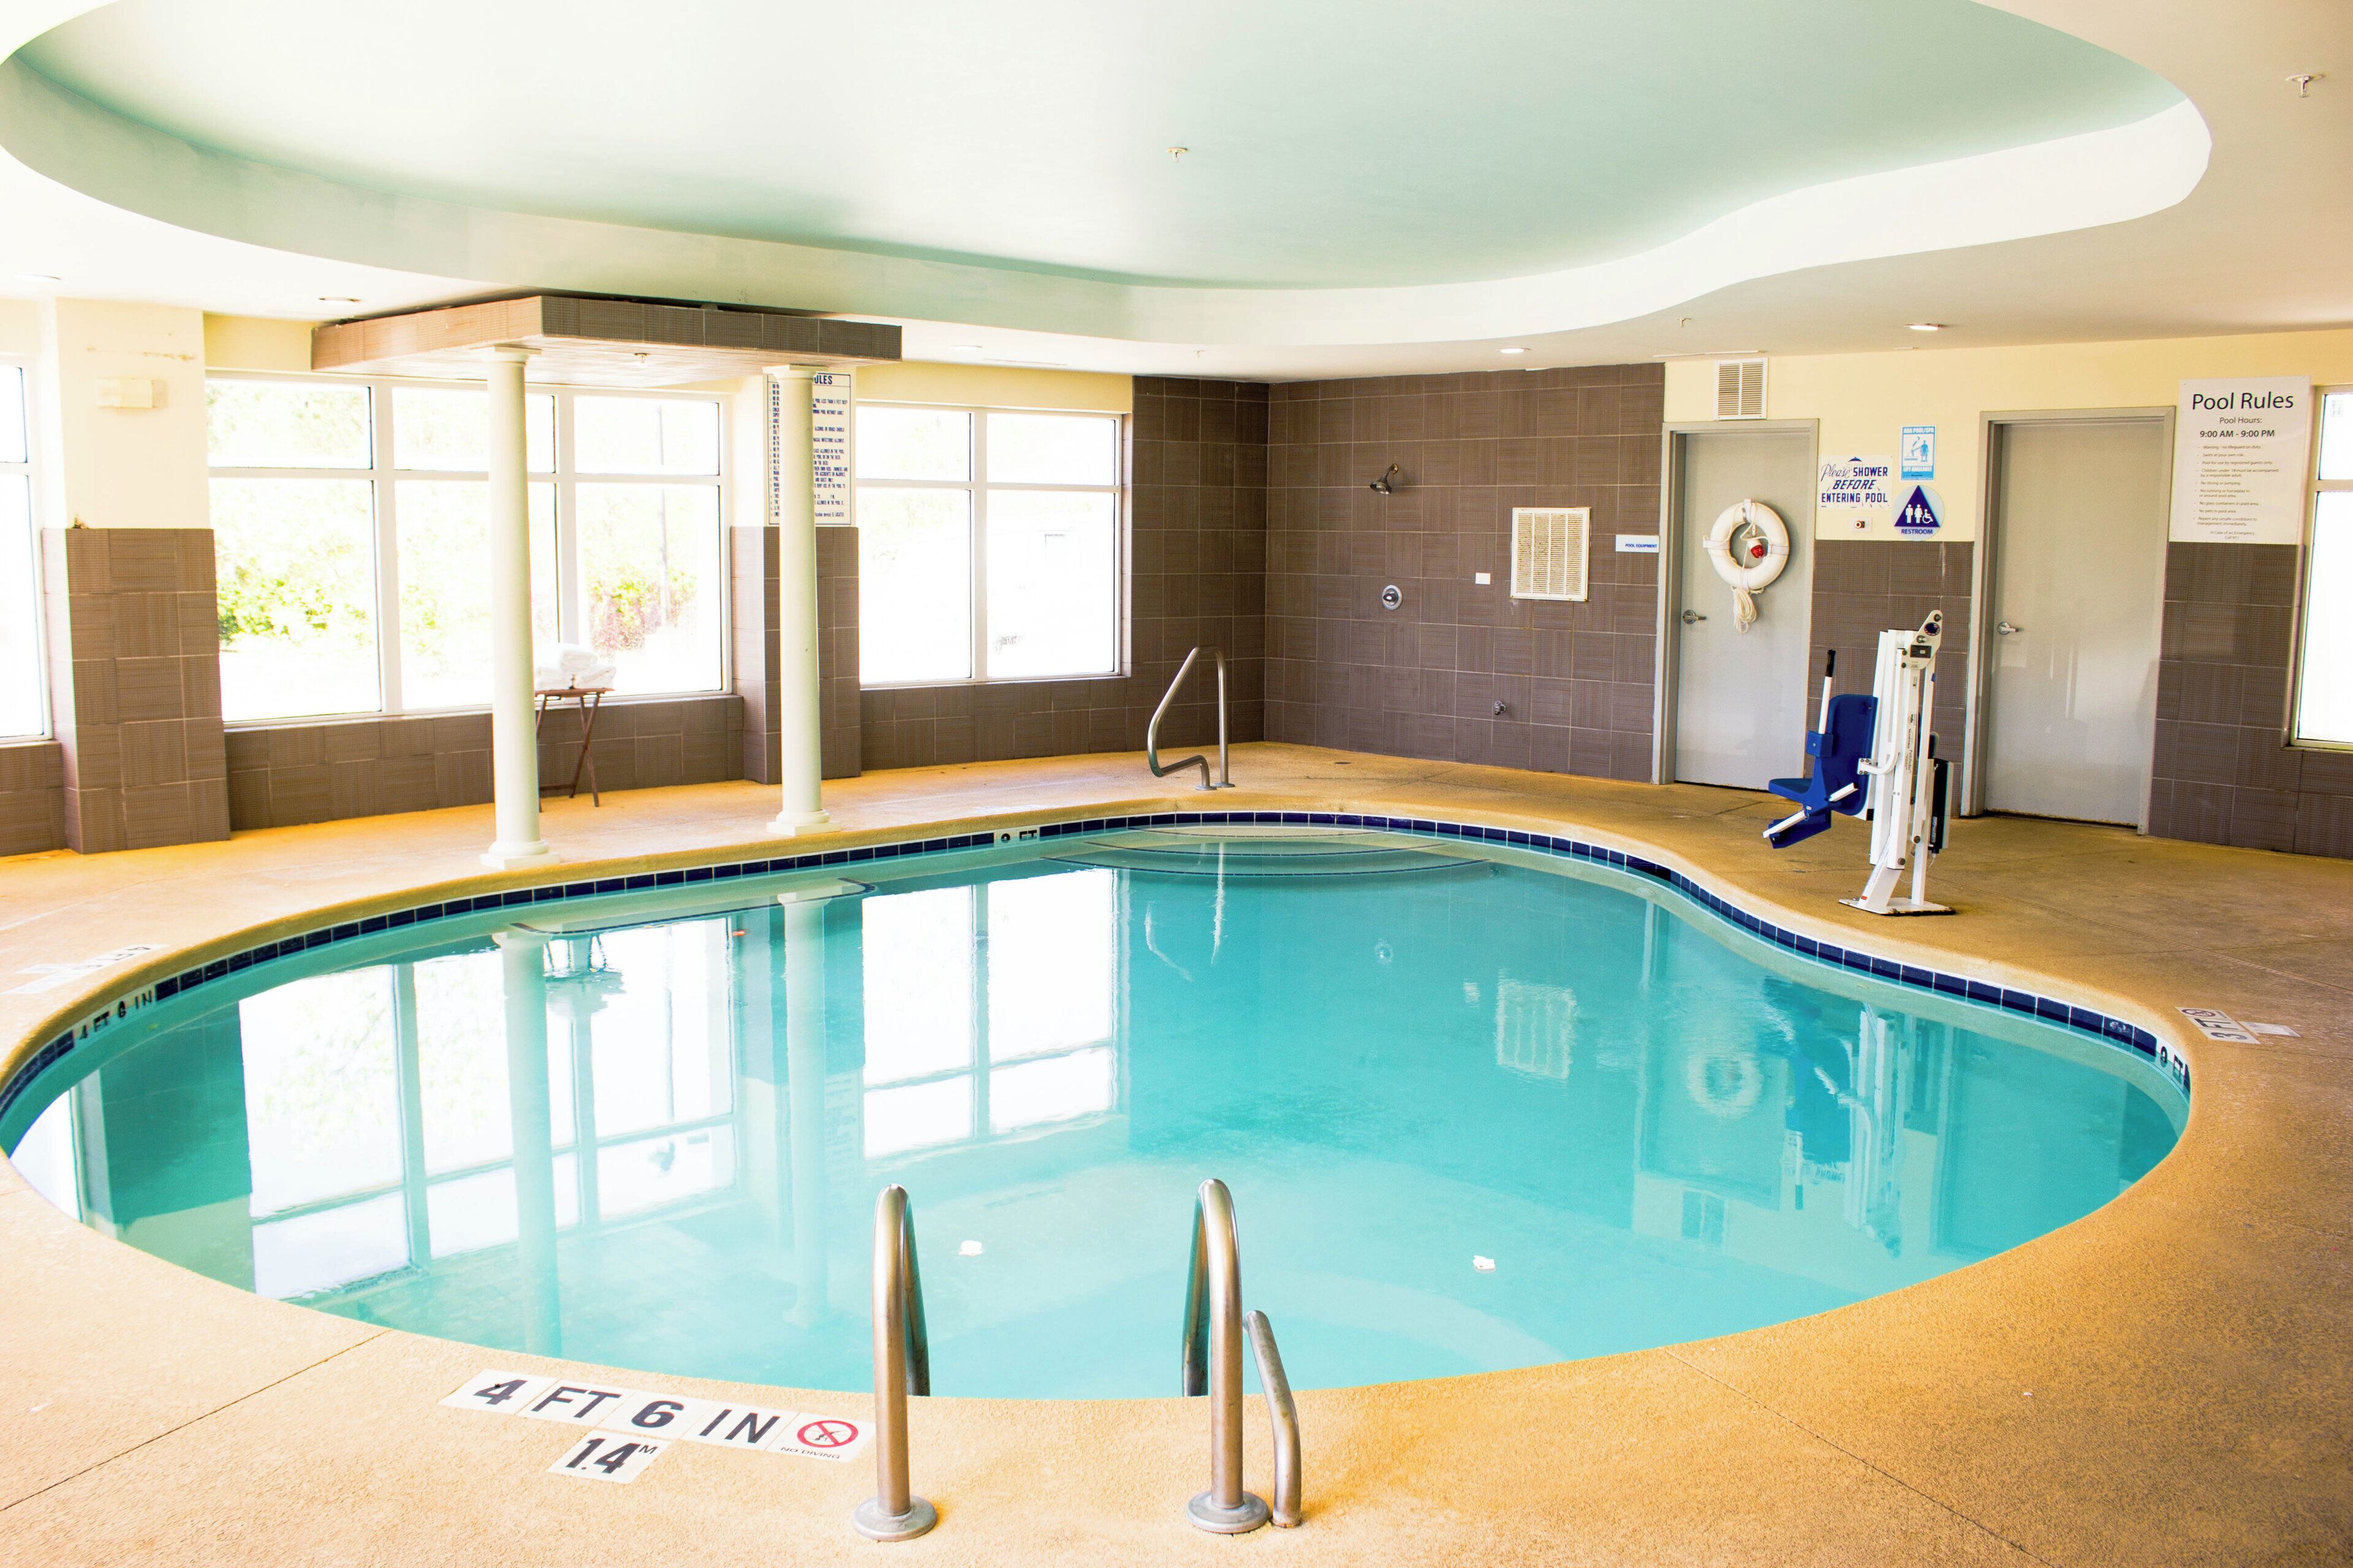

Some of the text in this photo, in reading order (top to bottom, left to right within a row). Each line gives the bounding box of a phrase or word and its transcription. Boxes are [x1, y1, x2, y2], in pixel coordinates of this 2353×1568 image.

[814, 375, 832, 384] ULES
[2192, 392, 2294, 410] Pool Rules
[1821, 462, 1888, 482] Please SHOWER
[1833, 480, 1876, 490] BEFORE
[1822, 493, 1888, 502] ENTERING POOL
[135, 990, 153, 1009] IN
[2193, 1018, 2239, 1030] FT
[473, 1379, 781, 1444] 4 FT 6 IN
[801, 1450, 841, 1459] DIVING
